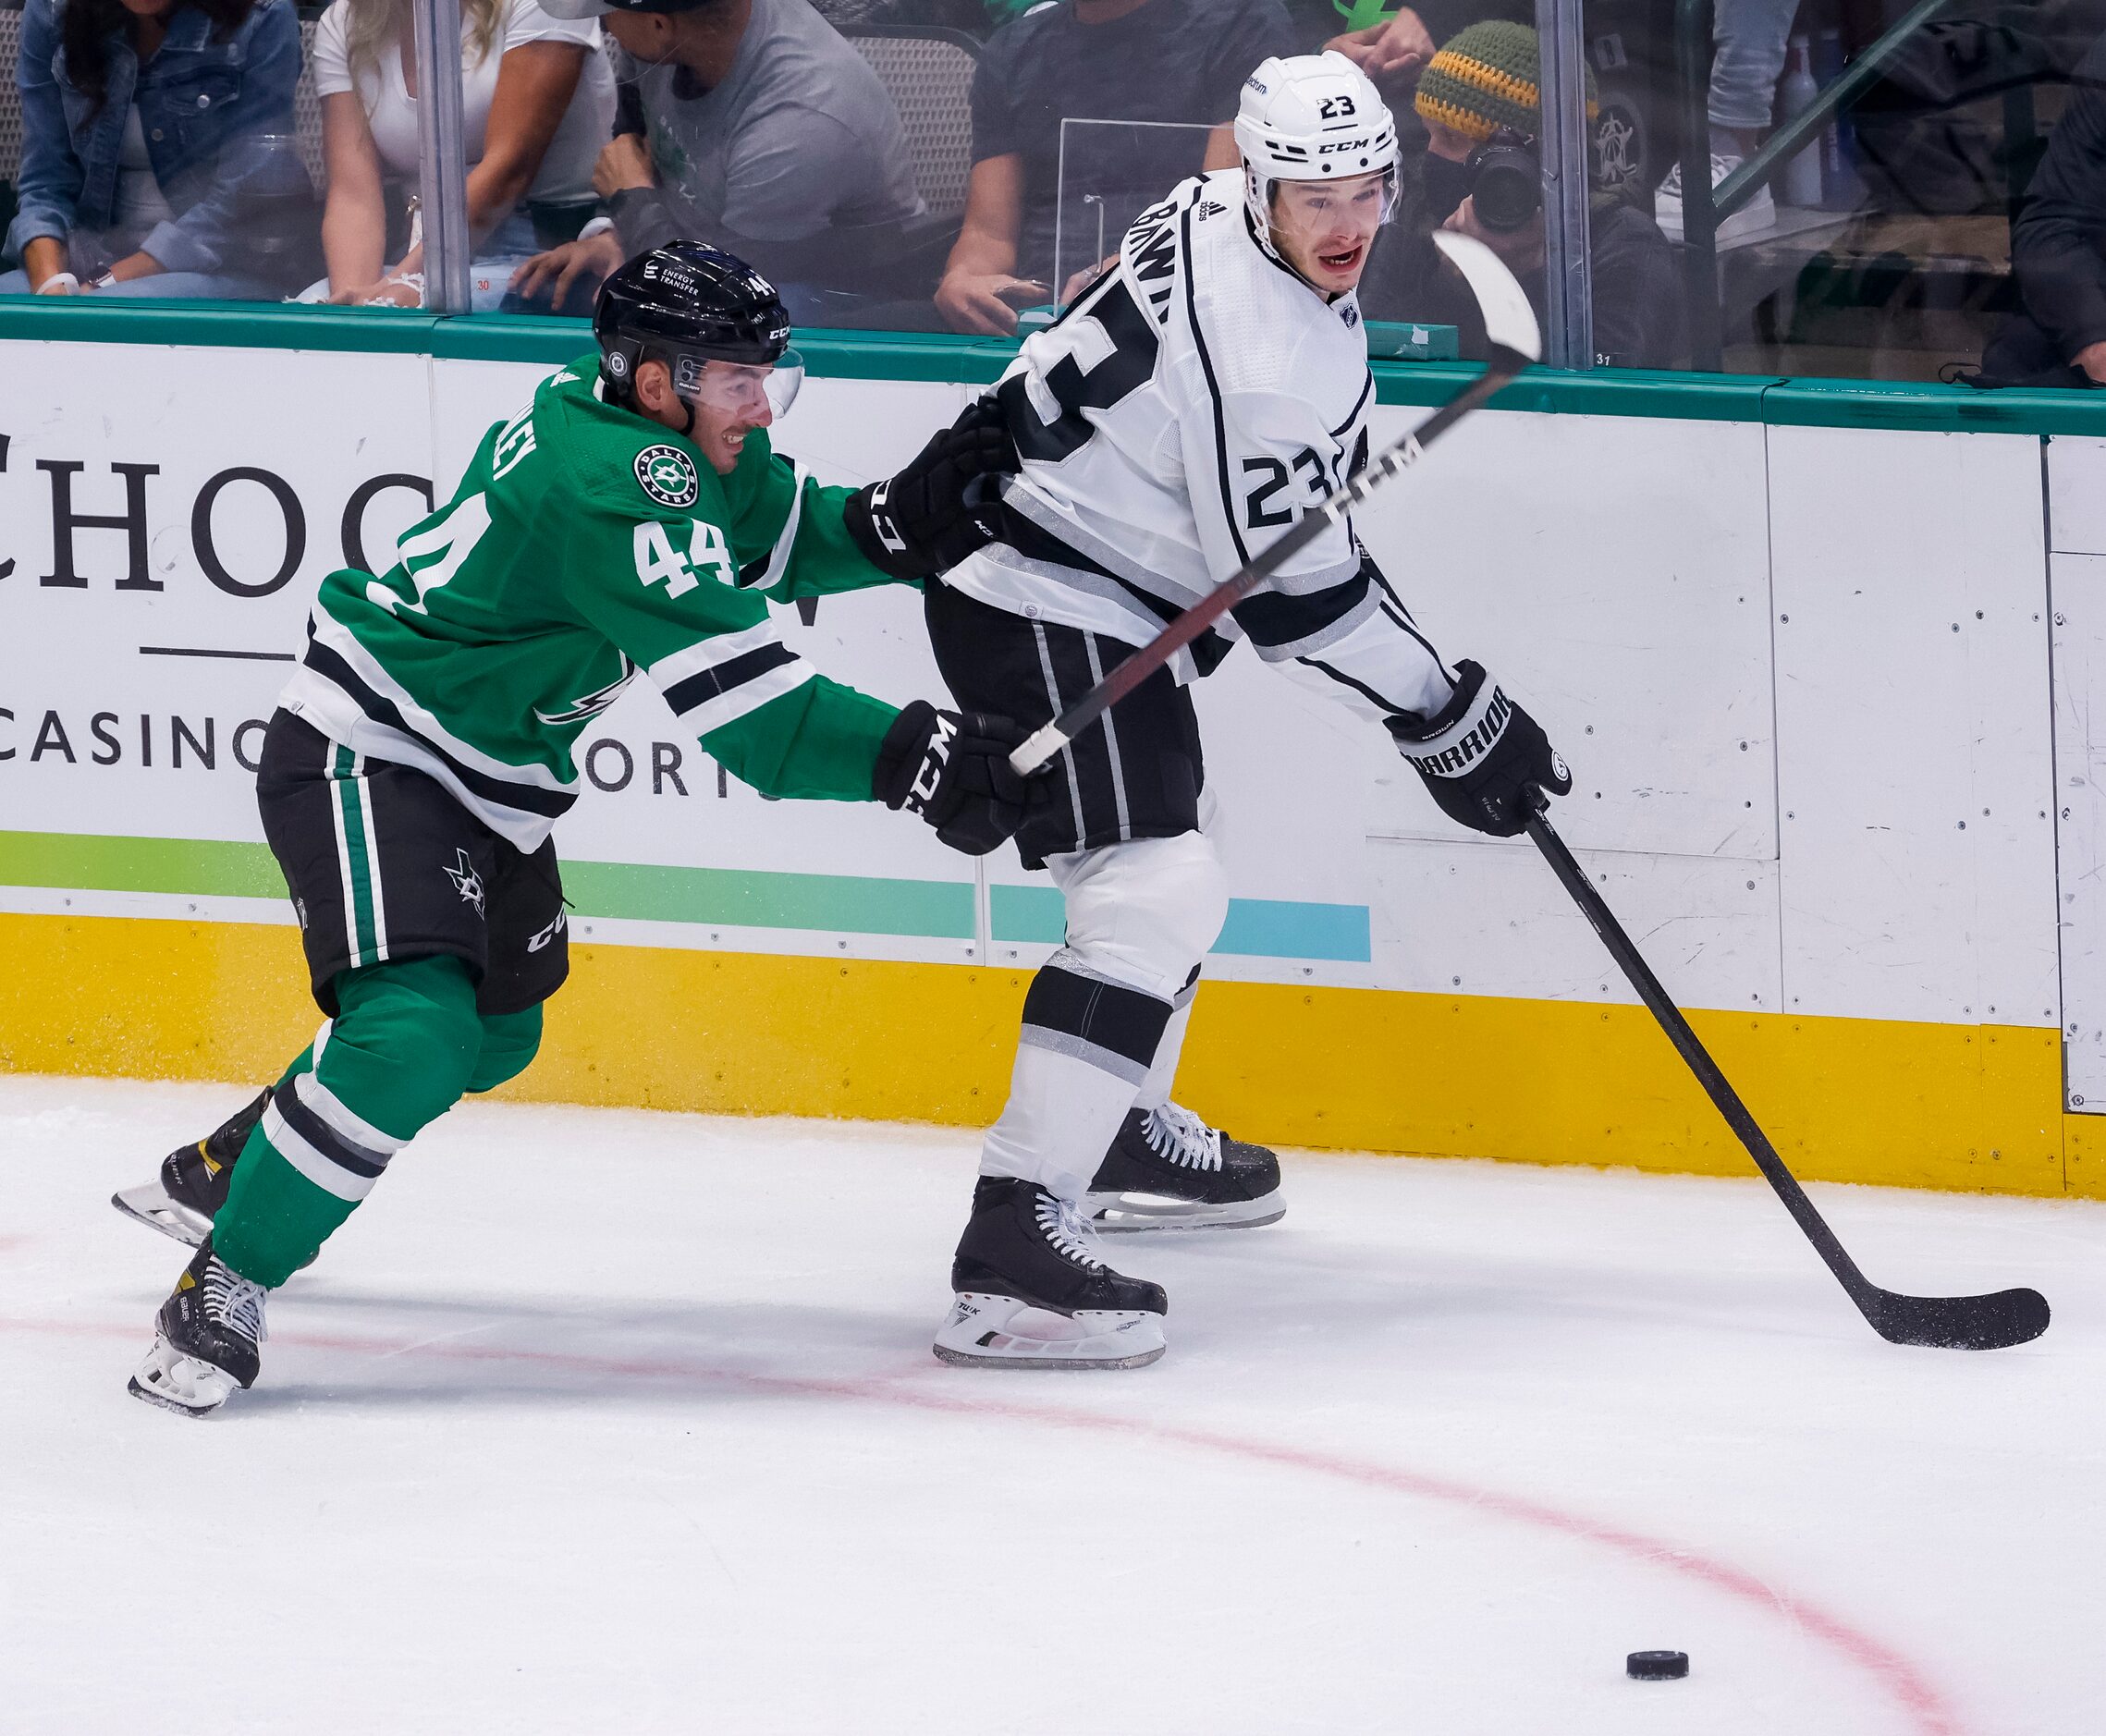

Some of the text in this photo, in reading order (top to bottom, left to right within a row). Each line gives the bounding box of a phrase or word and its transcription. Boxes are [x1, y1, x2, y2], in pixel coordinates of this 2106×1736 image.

[1317, 95, 1356, 119] 23
[1318, 139, 1369, 154] CCM
[477, 280, 489, 291] 30
[659, 275, 699, 297] TRANSFER
[663, 268, 694, 285] ENERGY
[1597, 353, 1610, 366] 31
[640, 448, 695, 484] DALLAS
[642, 474, 692, 504] STARS
[1241, 446, 1334, 530] 23
[0, 433, 435, 598] HOC
[633, 518, 736, 600] 44
